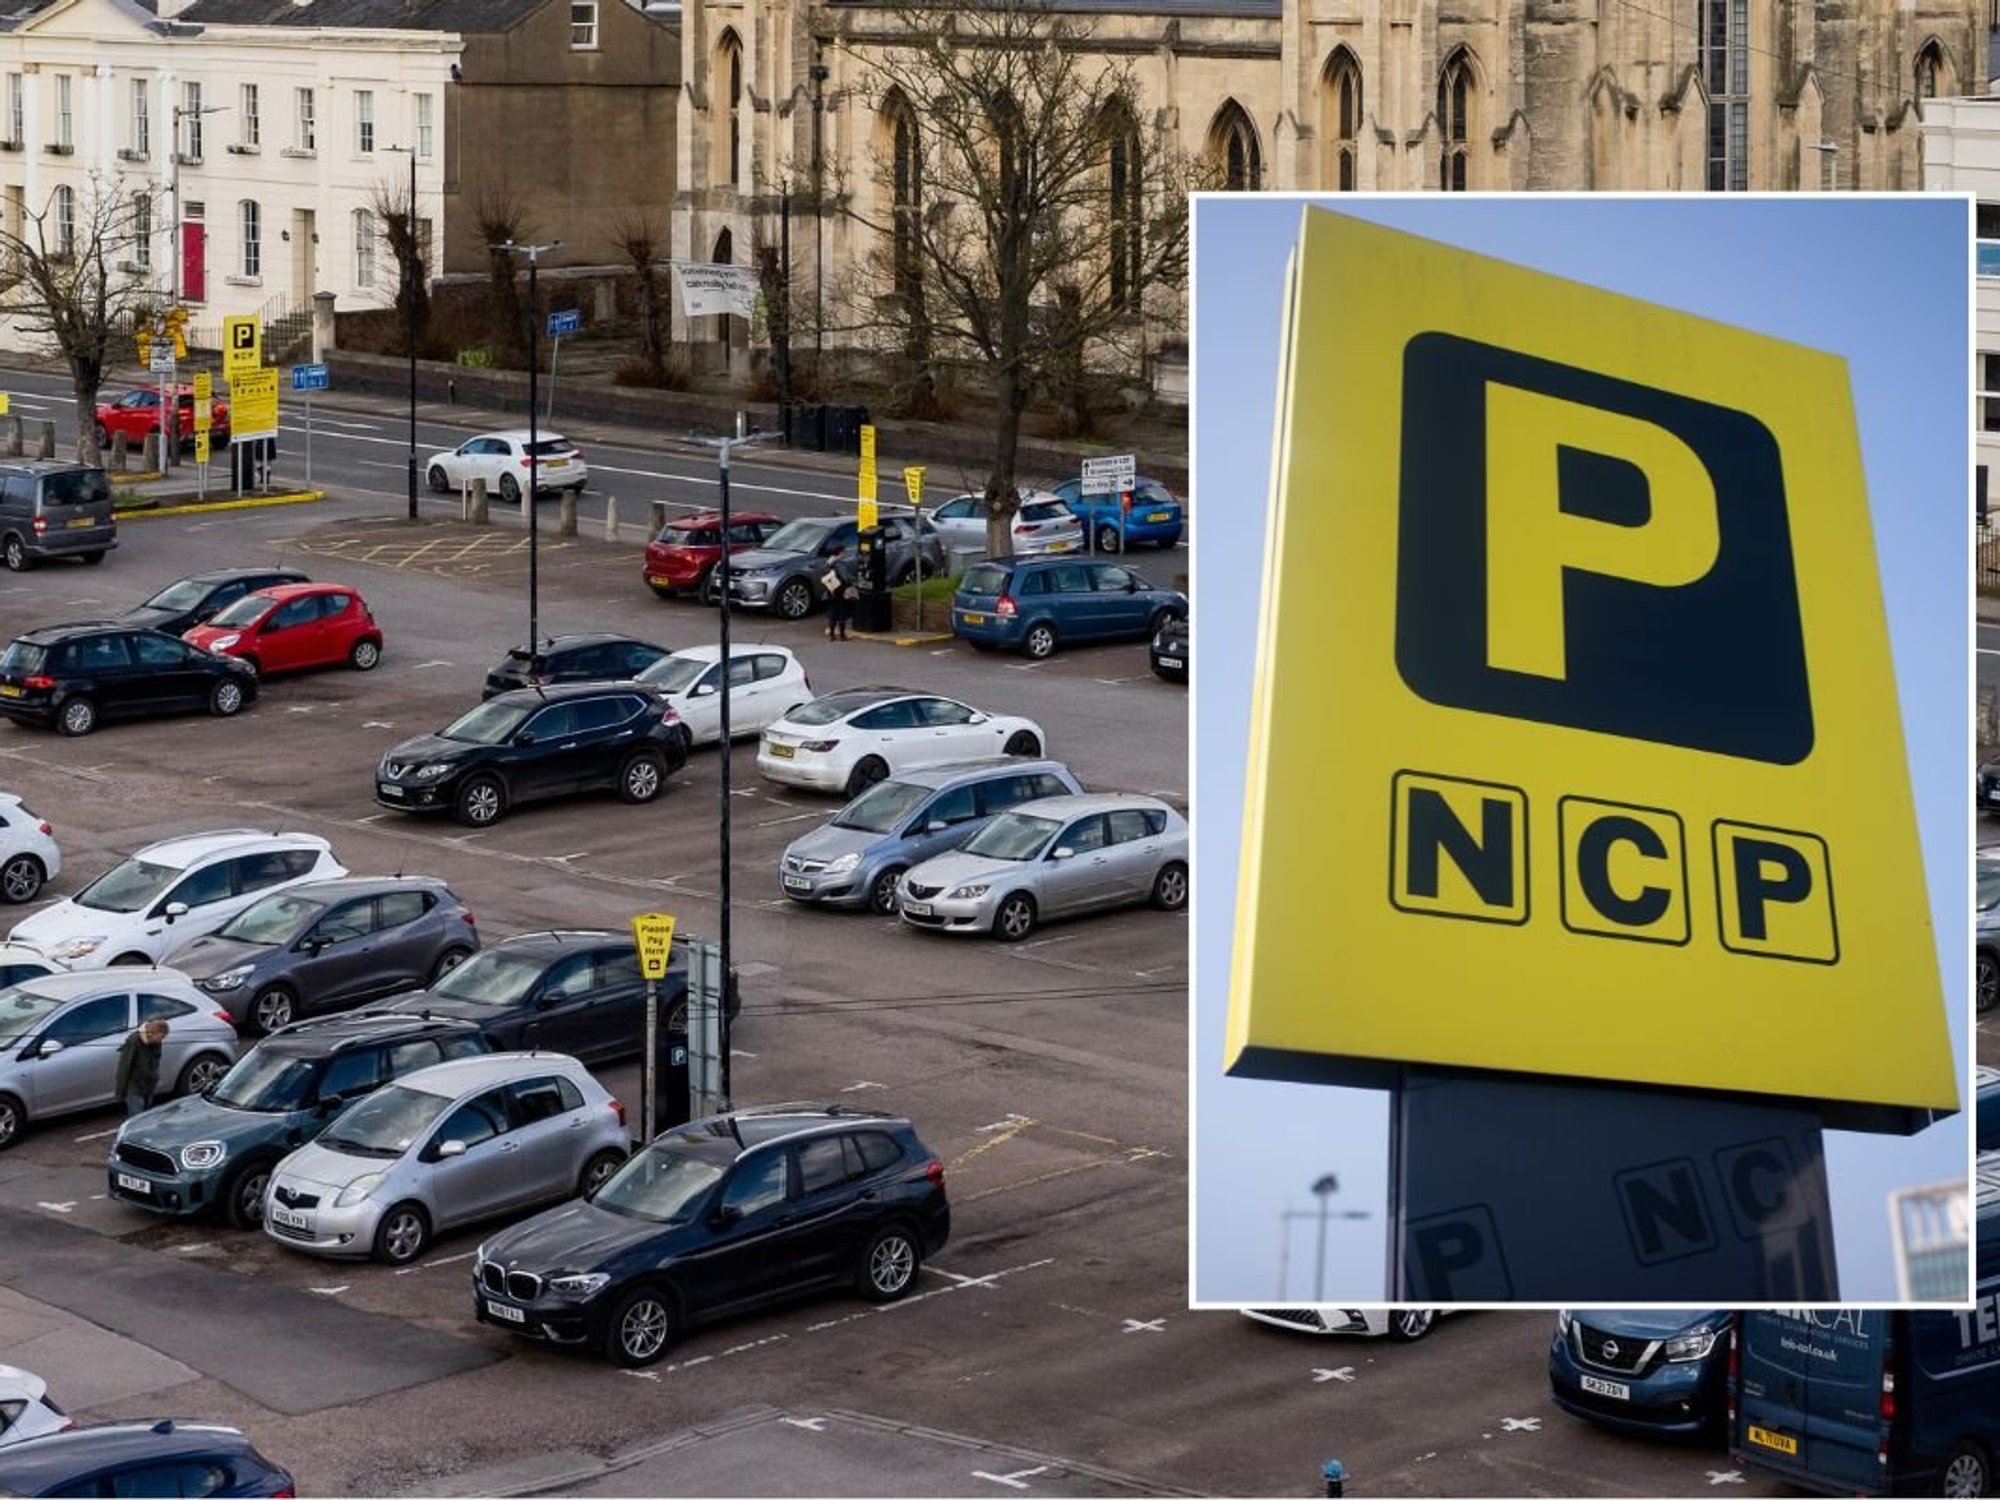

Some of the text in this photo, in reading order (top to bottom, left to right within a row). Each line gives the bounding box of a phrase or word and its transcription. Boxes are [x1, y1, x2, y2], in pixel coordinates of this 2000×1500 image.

[237, 326, 250, 346] P
[1485, 380, 1720, 681] P
[641, 924, 670, 933] Please
[647, 936, 663, 946] Pay
[645, 948, 664, 956] Here
